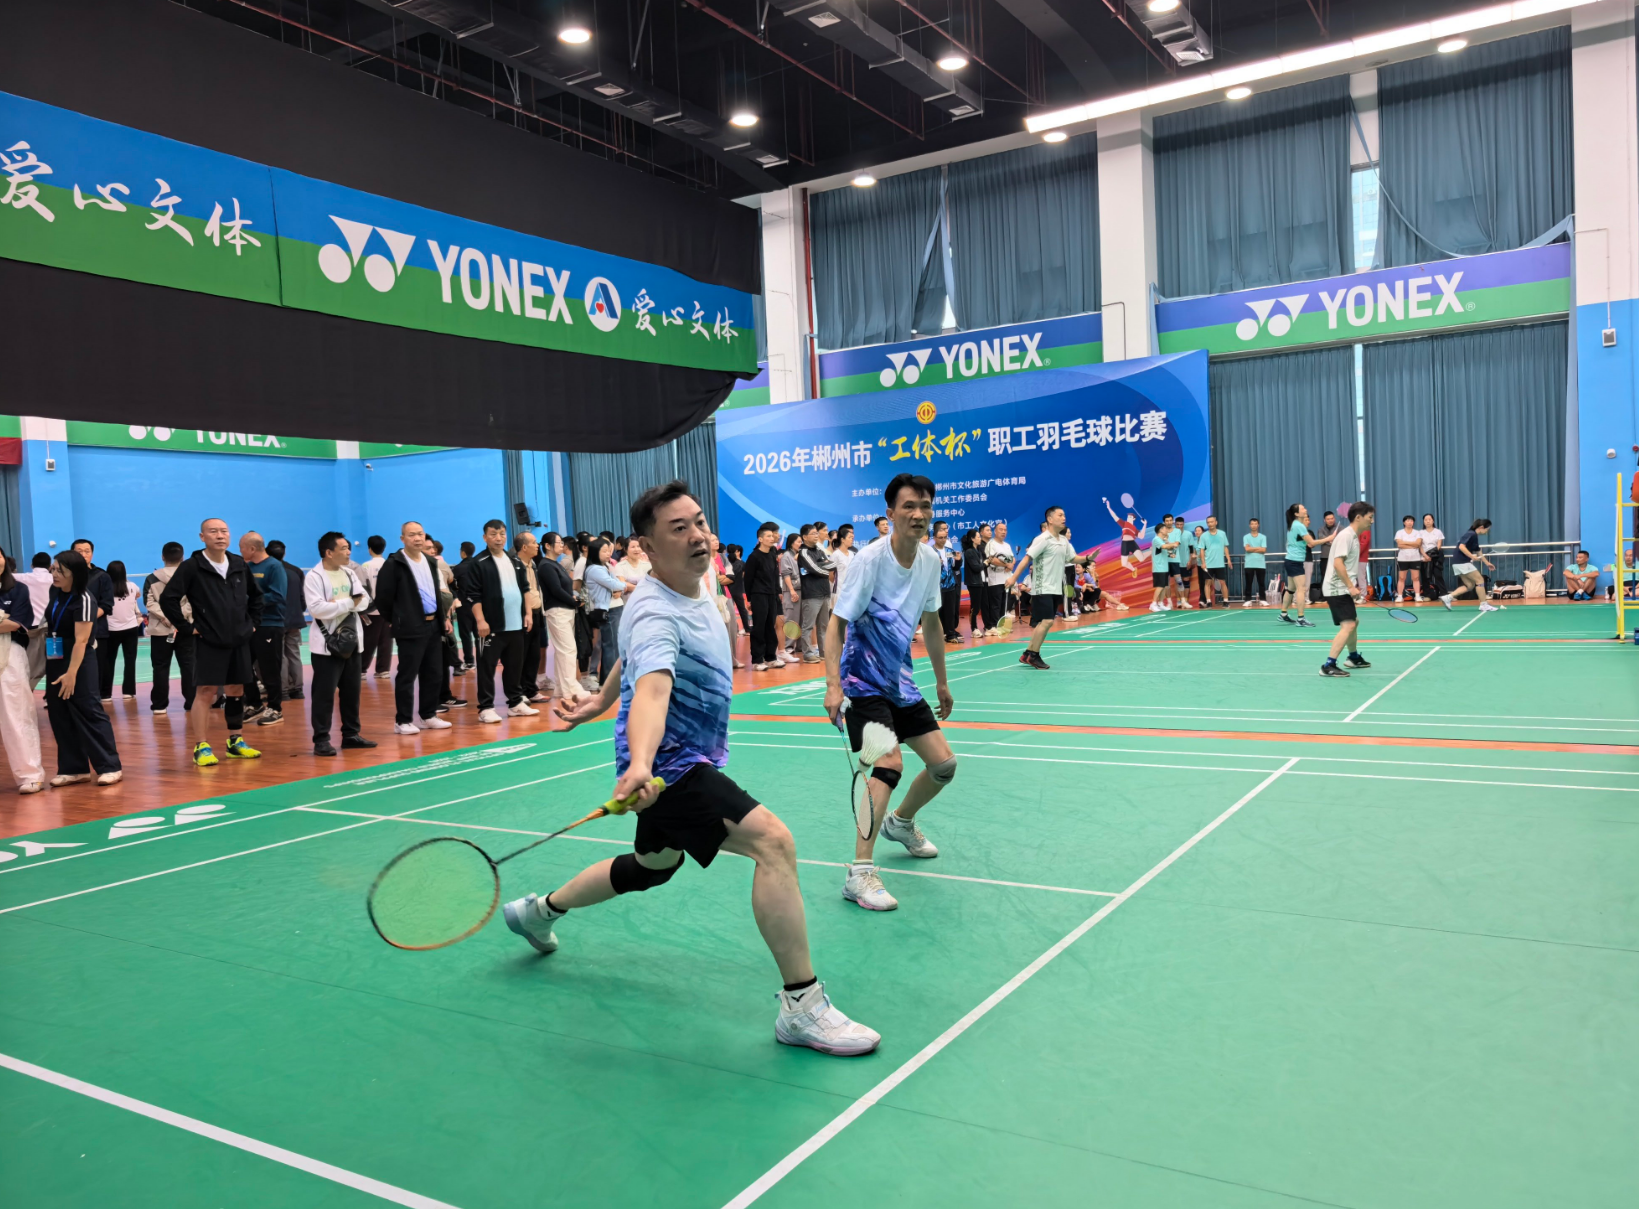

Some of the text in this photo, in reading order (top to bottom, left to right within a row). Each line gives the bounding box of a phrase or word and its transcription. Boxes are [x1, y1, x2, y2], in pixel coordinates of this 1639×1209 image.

[0, 140, 261, 256] 爱心文体
[427, 239, 573, 324] YONEX
[1319, 271, 1465, 330] YONEX
[632, 288, 739, 344] 爱心文体
[938, 332, 1043, 380] YONEX
